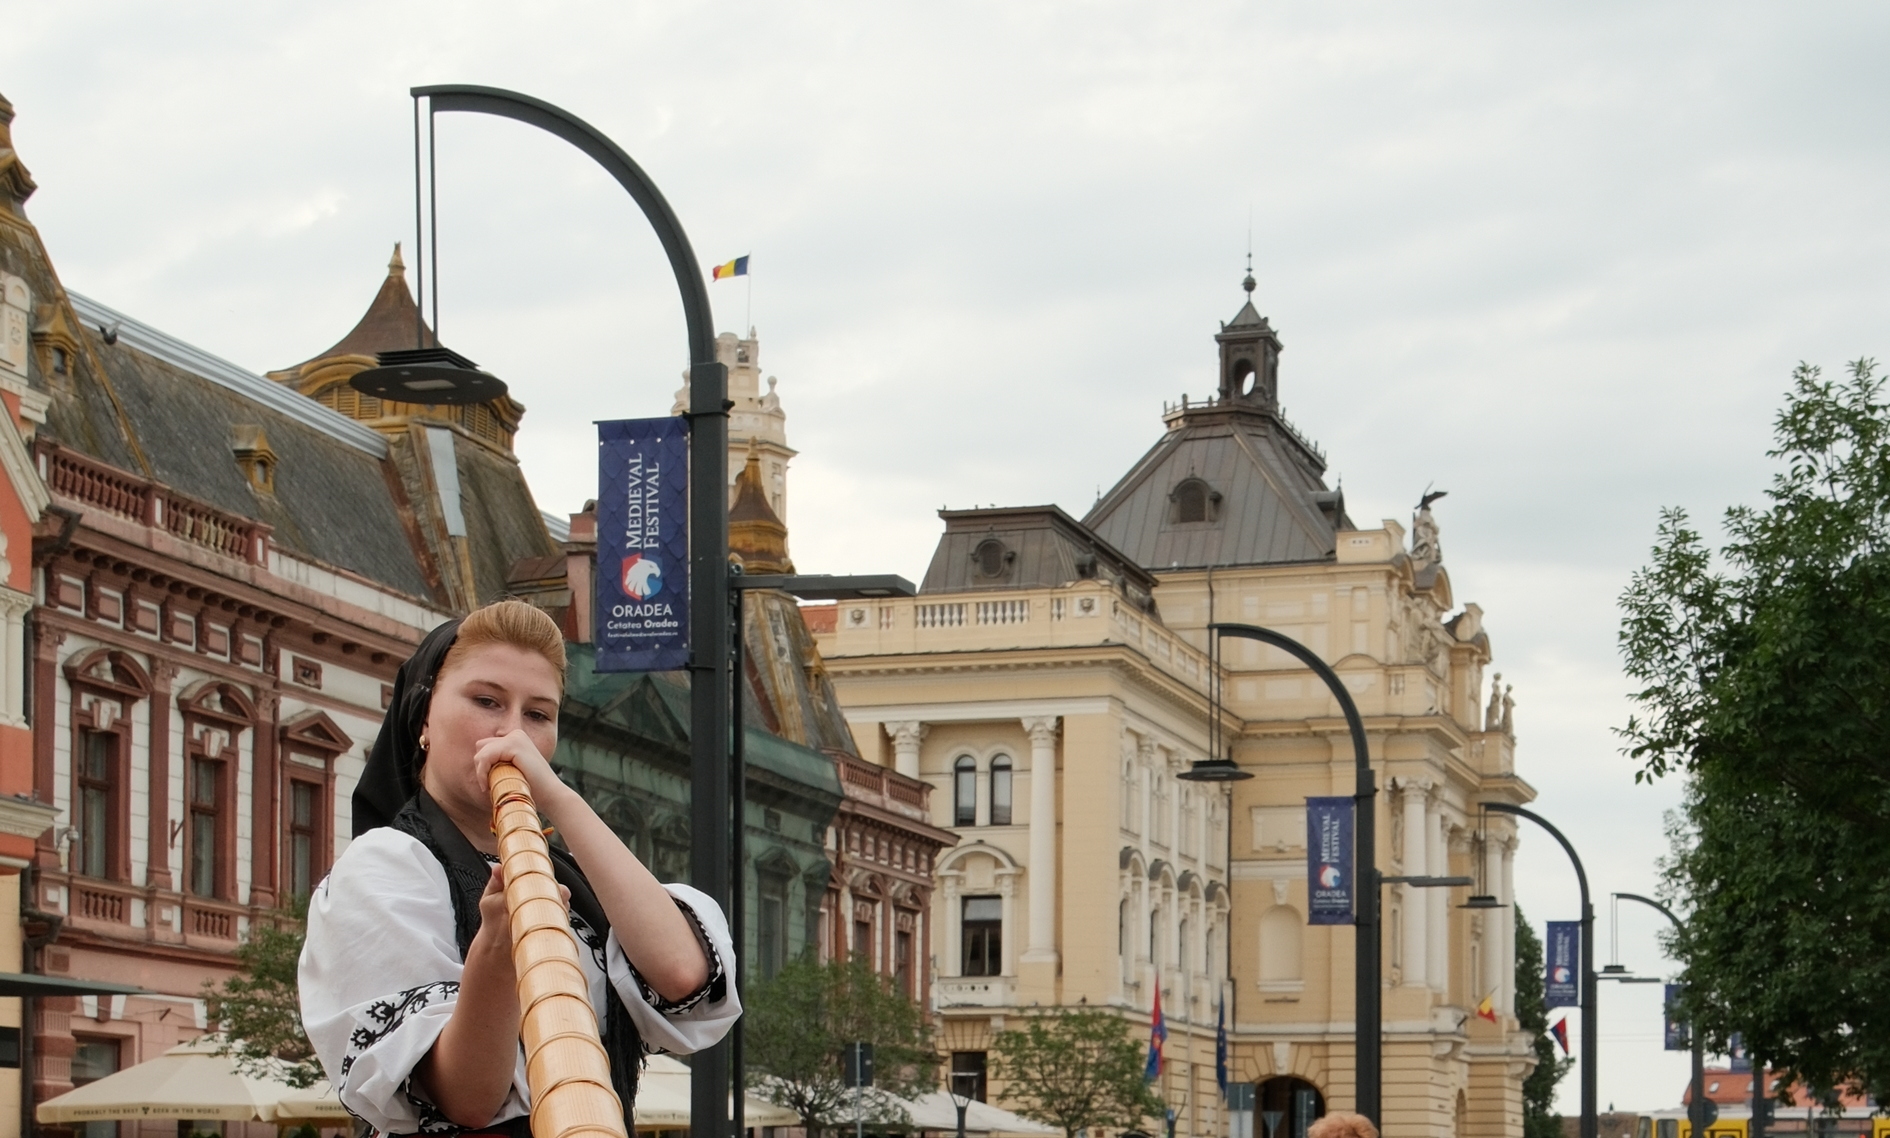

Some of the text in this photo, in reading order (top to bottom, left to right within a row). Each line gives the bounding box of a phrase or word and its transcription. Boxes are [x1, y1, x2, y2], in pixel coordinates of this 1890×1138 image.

[626, 453, 642, 549] MEDIEVAL
[644, 462, 660, 549] FESTIVAL
[607, 618, 678, 629] Cetatea Oradea
[612, 603, 673, 617] ORADEA
